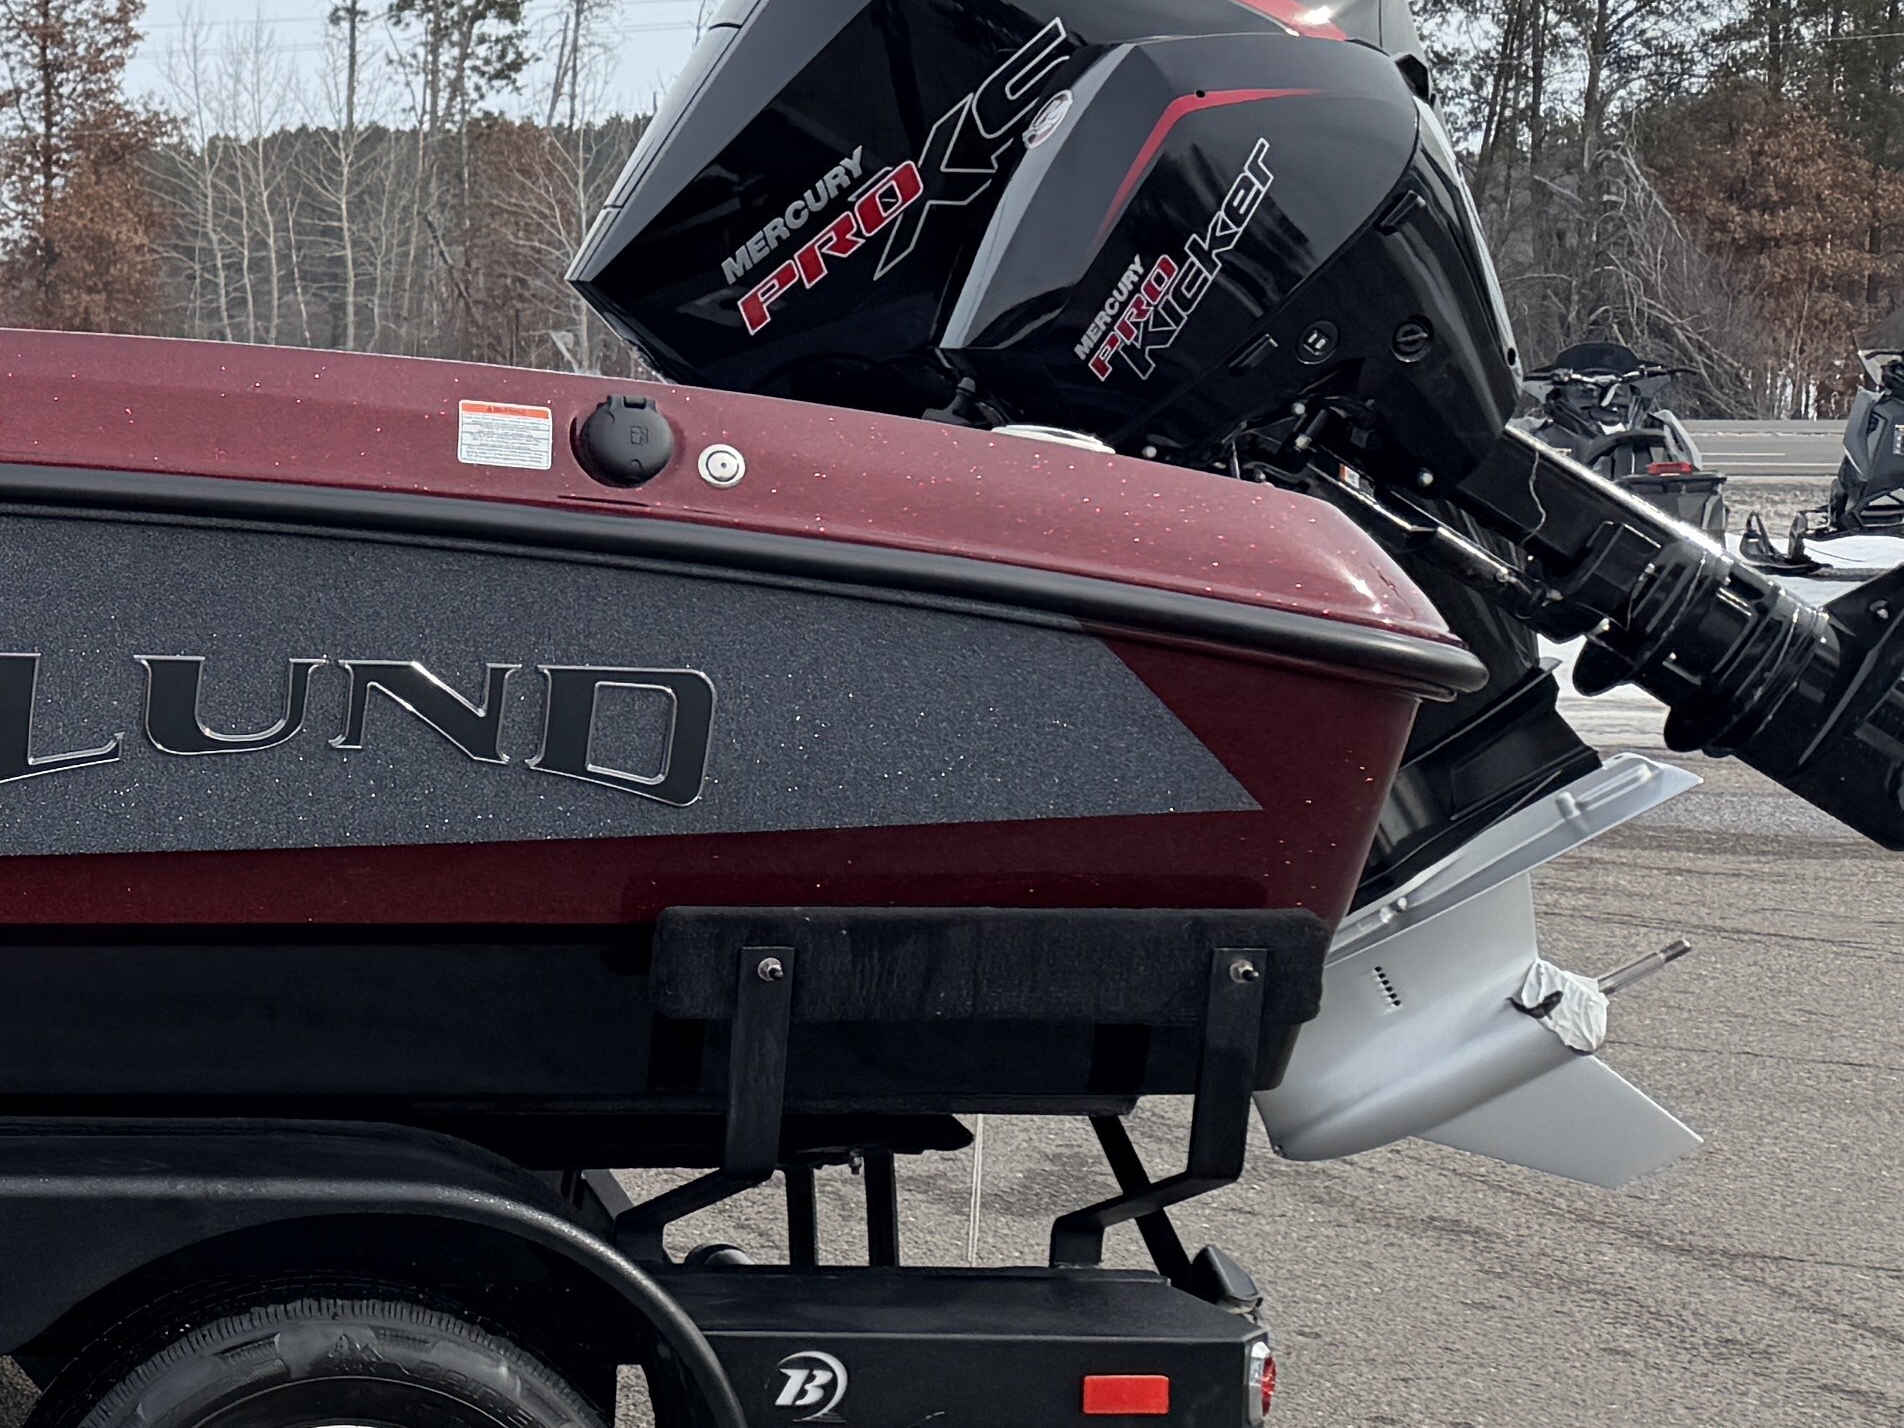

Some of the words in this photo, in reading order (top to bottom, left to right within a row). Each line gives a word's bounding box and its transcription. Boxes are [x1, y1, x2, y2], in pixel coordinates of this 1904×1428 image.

[721, 145, 864, 284] MERCURY
[737, 160, 924, 335] PRO
[848, 17, 1070, 281] XS
[1074, 253, 1145, 360] MERCURY
[1088, 254, 1178, 381] PRO
[1118, 137, 1274, 380] Kicker
